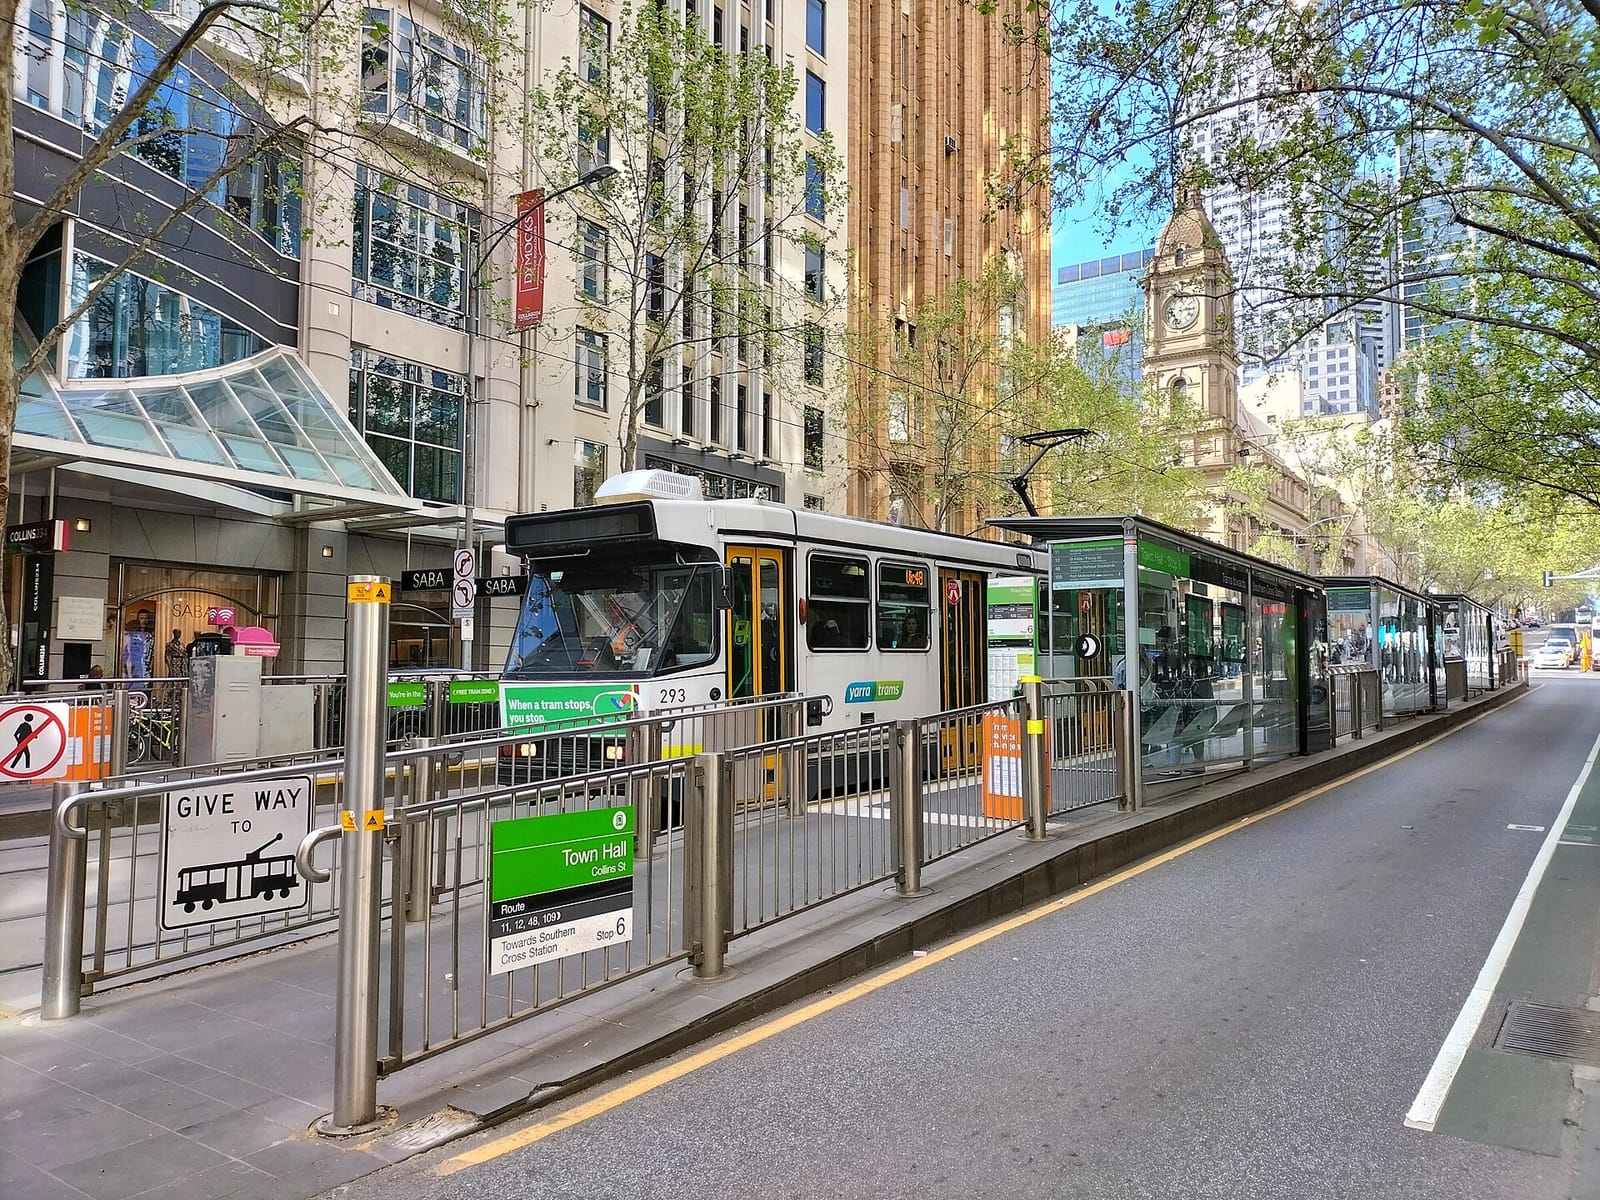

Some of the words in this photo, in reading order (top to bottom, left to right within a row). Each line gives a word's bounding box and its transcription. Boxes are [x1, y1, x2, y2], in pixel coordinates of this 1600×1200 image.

[525, 216, 533, 284] DYMOCKS
[412, 572, 445, 589] SABA
[485, 579, 517, 594] SABA
[1027, 625, 1033, 634] 6
[389, 690, 406, 698] You're
[660, 688, 686, 703] 293
[849, 686, 871, 701] yarra
[878, 684, 900, 696] trams
[508, 699, 533, 710] When
[534, 701, 540, 710] a
[541, 699, 563, 710] tram
[564, 699, 593, 712] stops,
[509, 713, 525, 725] you
[177, 793, 234, 818] GIVE
[254, 787, 302, 811] WAY
[230, 820, 252, 834] TO
[561, 848, 598, 867] Town
[602, 840, 627, 860] Hall
[591, 864, 617, 877] Collins
[617, 861, 627, 872] St
[501, 901, 525, 915] Route
[501, 921, 512, 933] 11,
[514, 919, 526, 931] 12,
[527, 916, 540, 928] 48,
[596, 928, 614, 942] Stop
[616, 916, 626, 937] 6
[501, 935, 537, 952] Towards
[539, 926, 576, 943] Southern
[501, 950, 527, 966] Cross
[528, 943, 558, 959] Station
